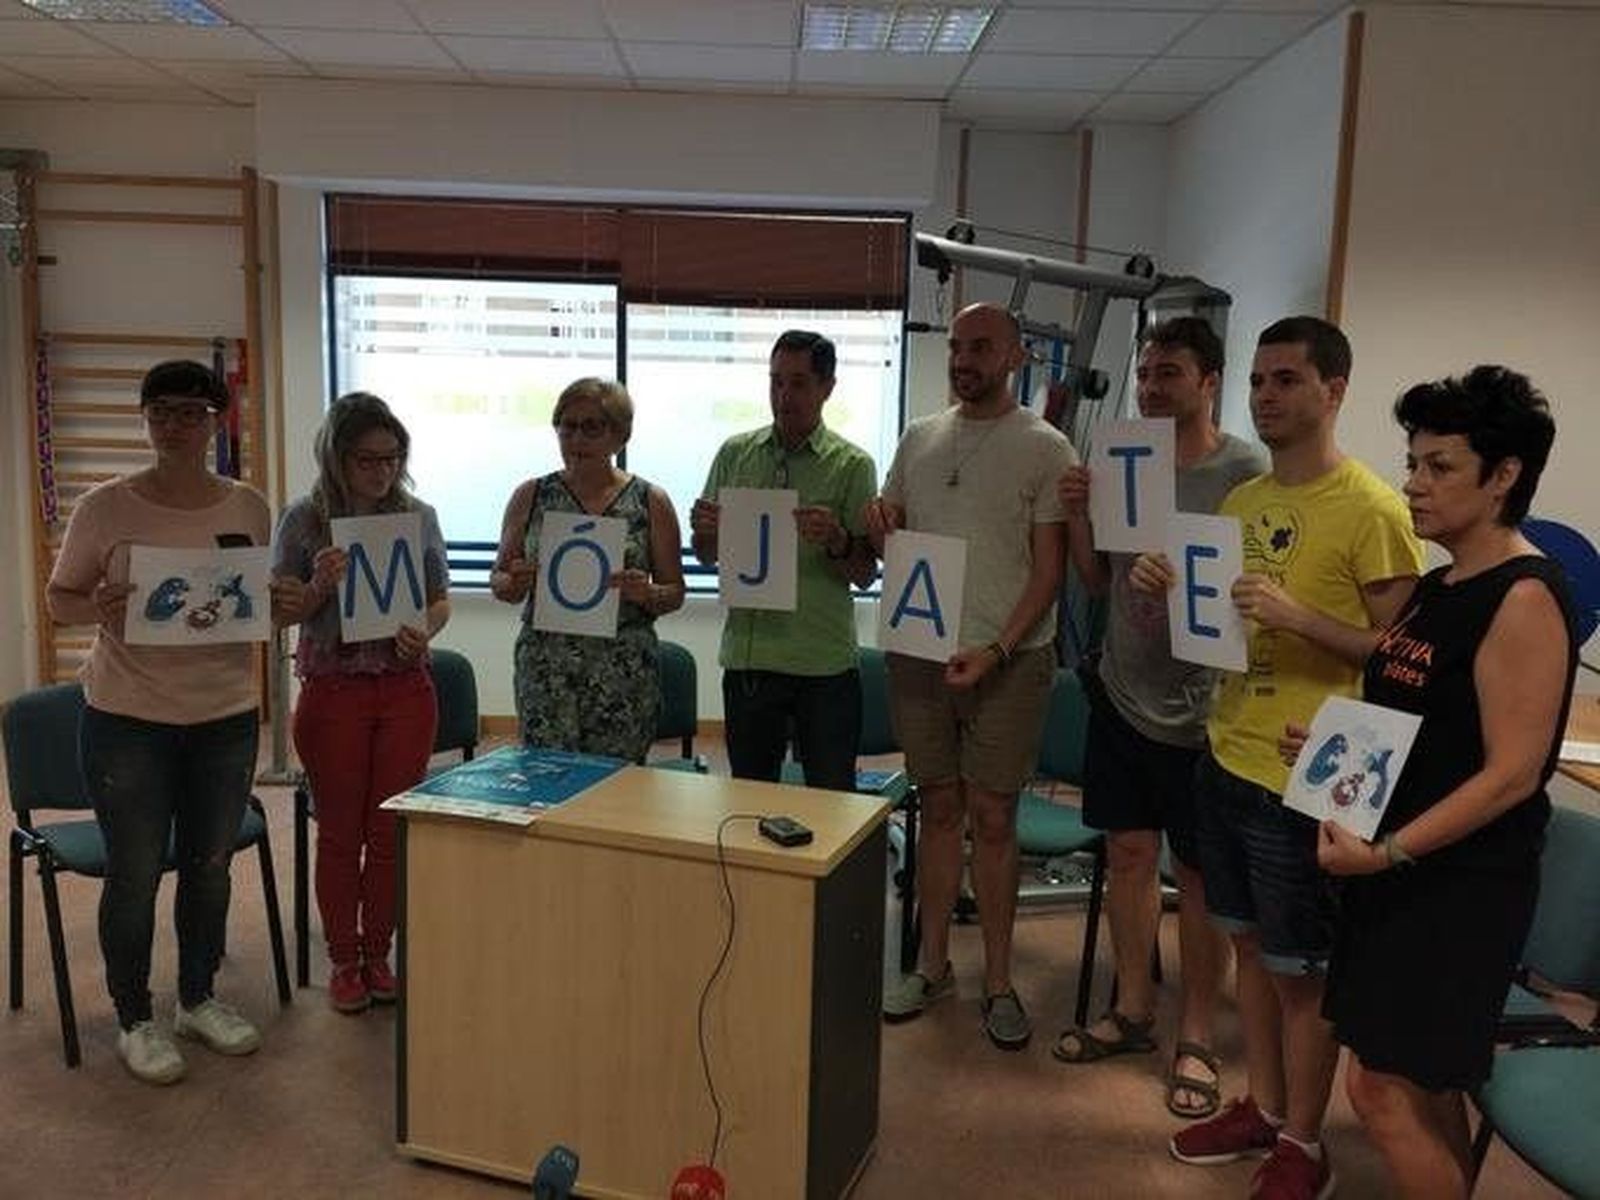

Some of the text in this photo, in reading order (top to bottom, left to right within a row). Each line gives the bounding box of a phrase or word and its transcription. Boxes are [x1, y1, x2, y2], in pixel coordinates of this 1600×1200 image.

[1107, 446, 1153, 528] T
[345, 538, 423, 618] M
[547, 521, 611, 611] Ó
[738, 513, 770, 587] J
[889, 558, 945, 637] A
[1185, 544, 1221, 638] E
